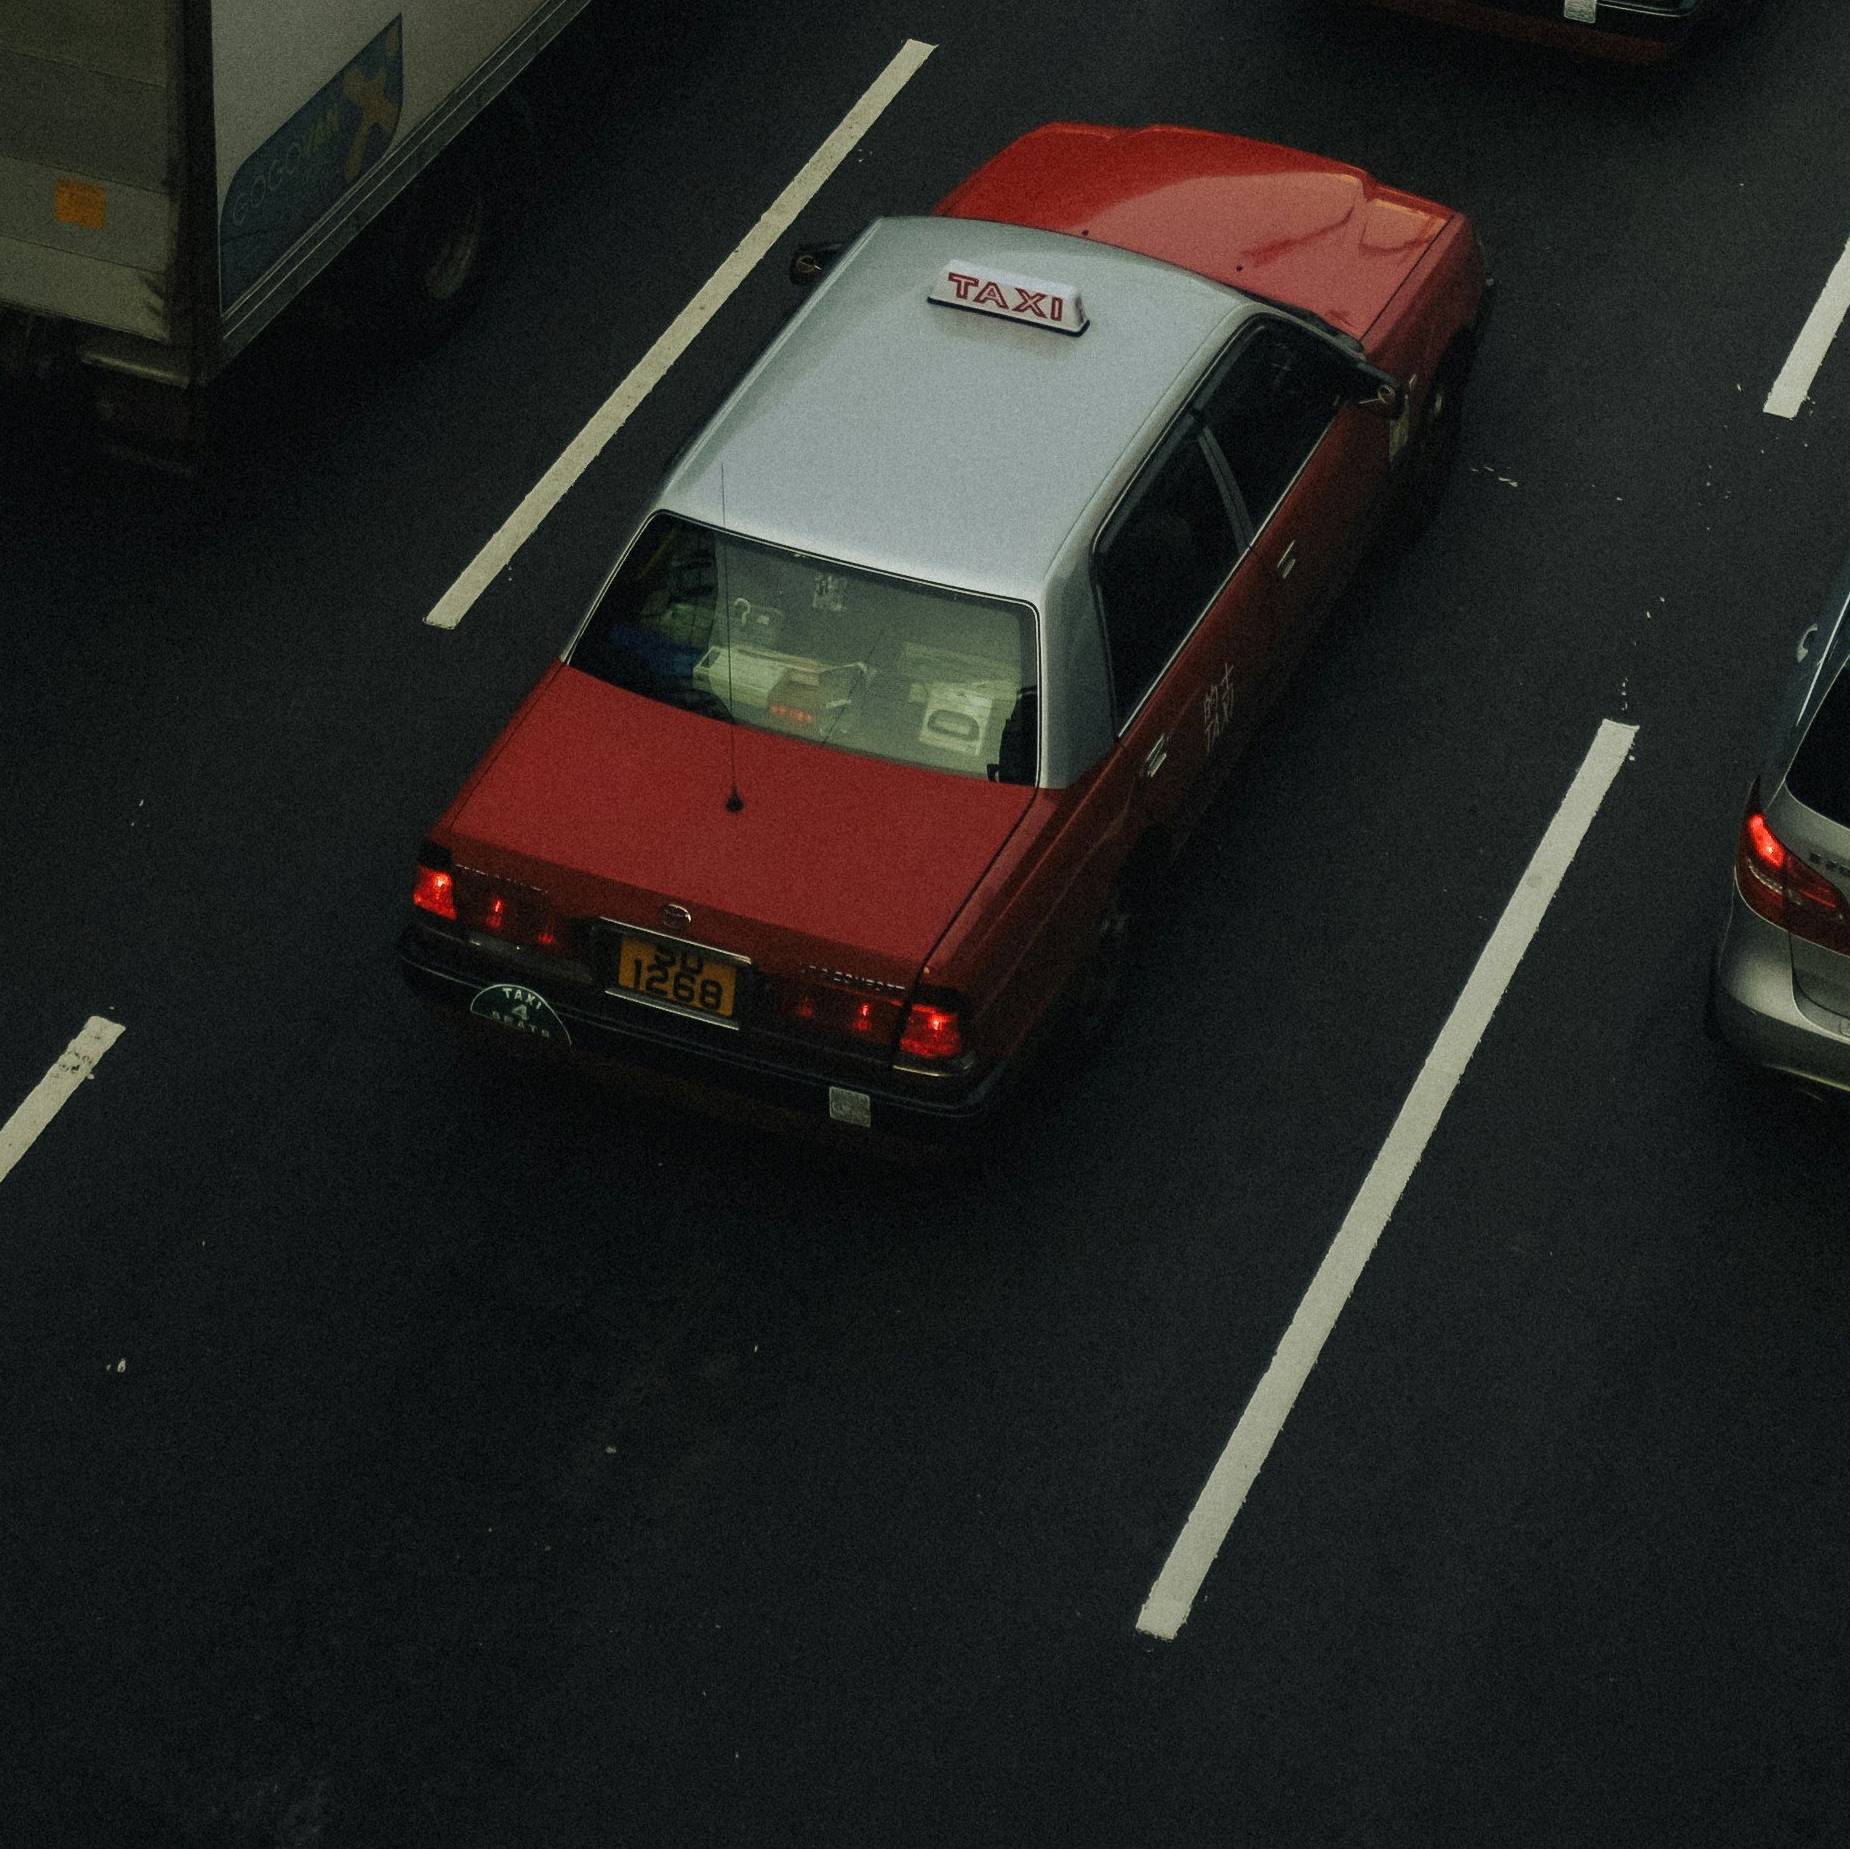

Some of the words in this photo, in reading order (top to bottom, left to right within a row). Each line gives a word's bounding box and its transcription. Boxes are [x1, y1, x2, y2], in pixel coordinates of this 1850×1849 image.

[950, 269, 1066, 323] TAXI
[501, 986, 543, 1012] TAXI
[631, 958, 725, 1012] 1268
[511, 1003, 530, 1023] 4
